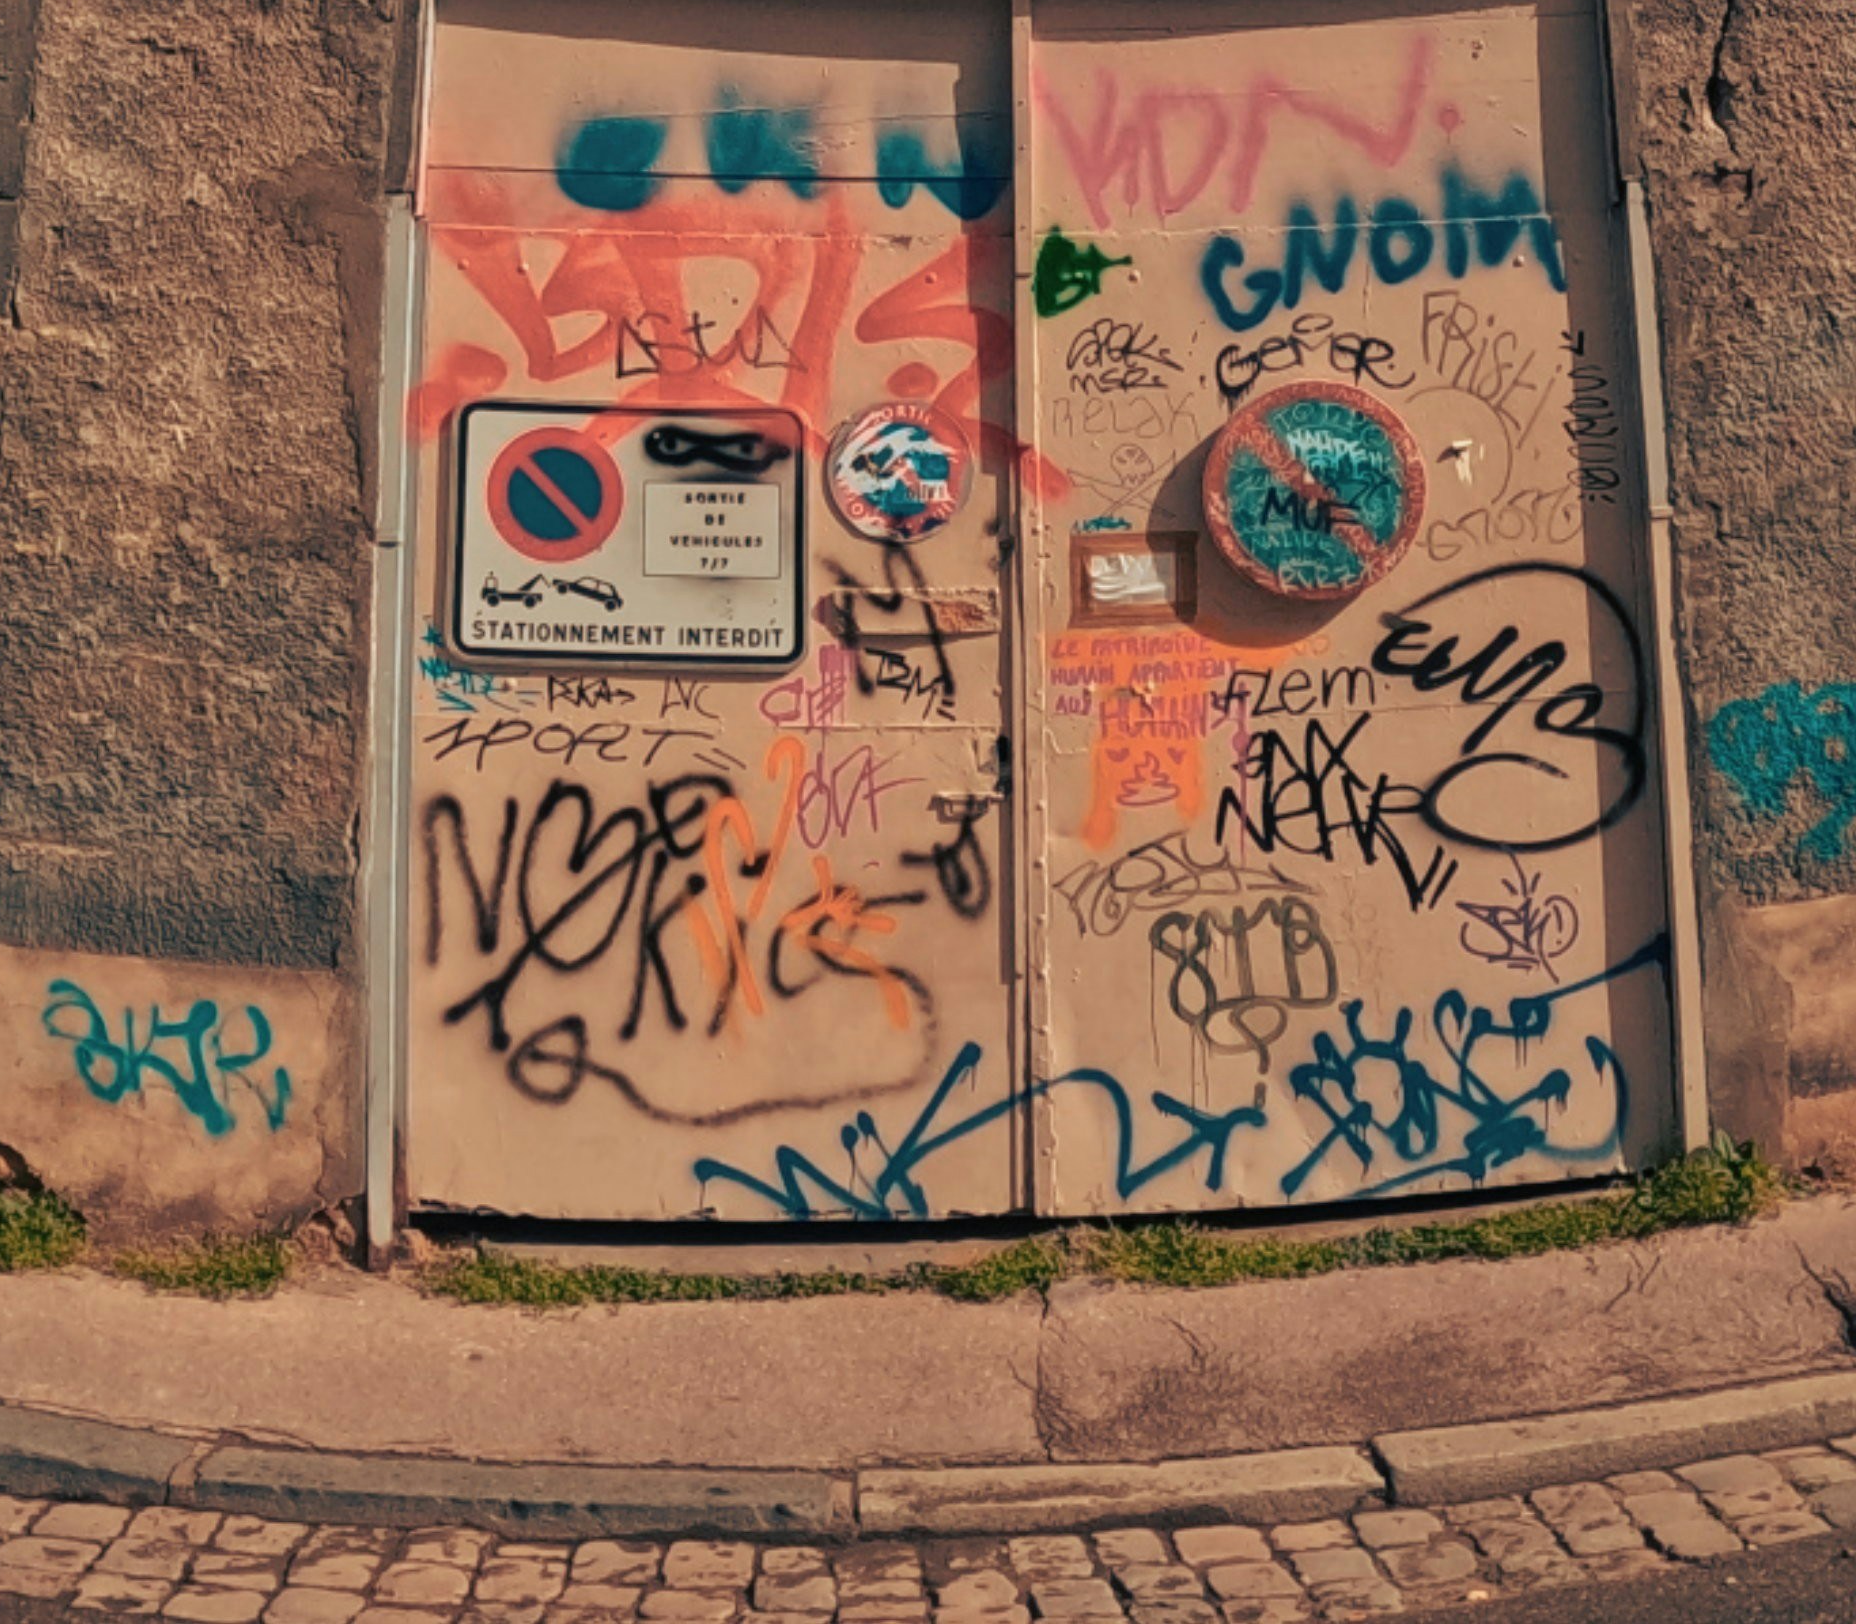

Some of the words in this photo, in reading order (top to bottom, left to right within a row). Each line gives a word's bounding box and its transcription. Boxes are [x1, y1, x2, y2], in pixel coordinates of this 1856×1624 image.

[684, 492, 747, 505] SORTIE
[704, 513, 726, 526] DE
[472, 619, 666, 646] STATIONNEMENT
[678, 626, 784, 649] INTERDIT
